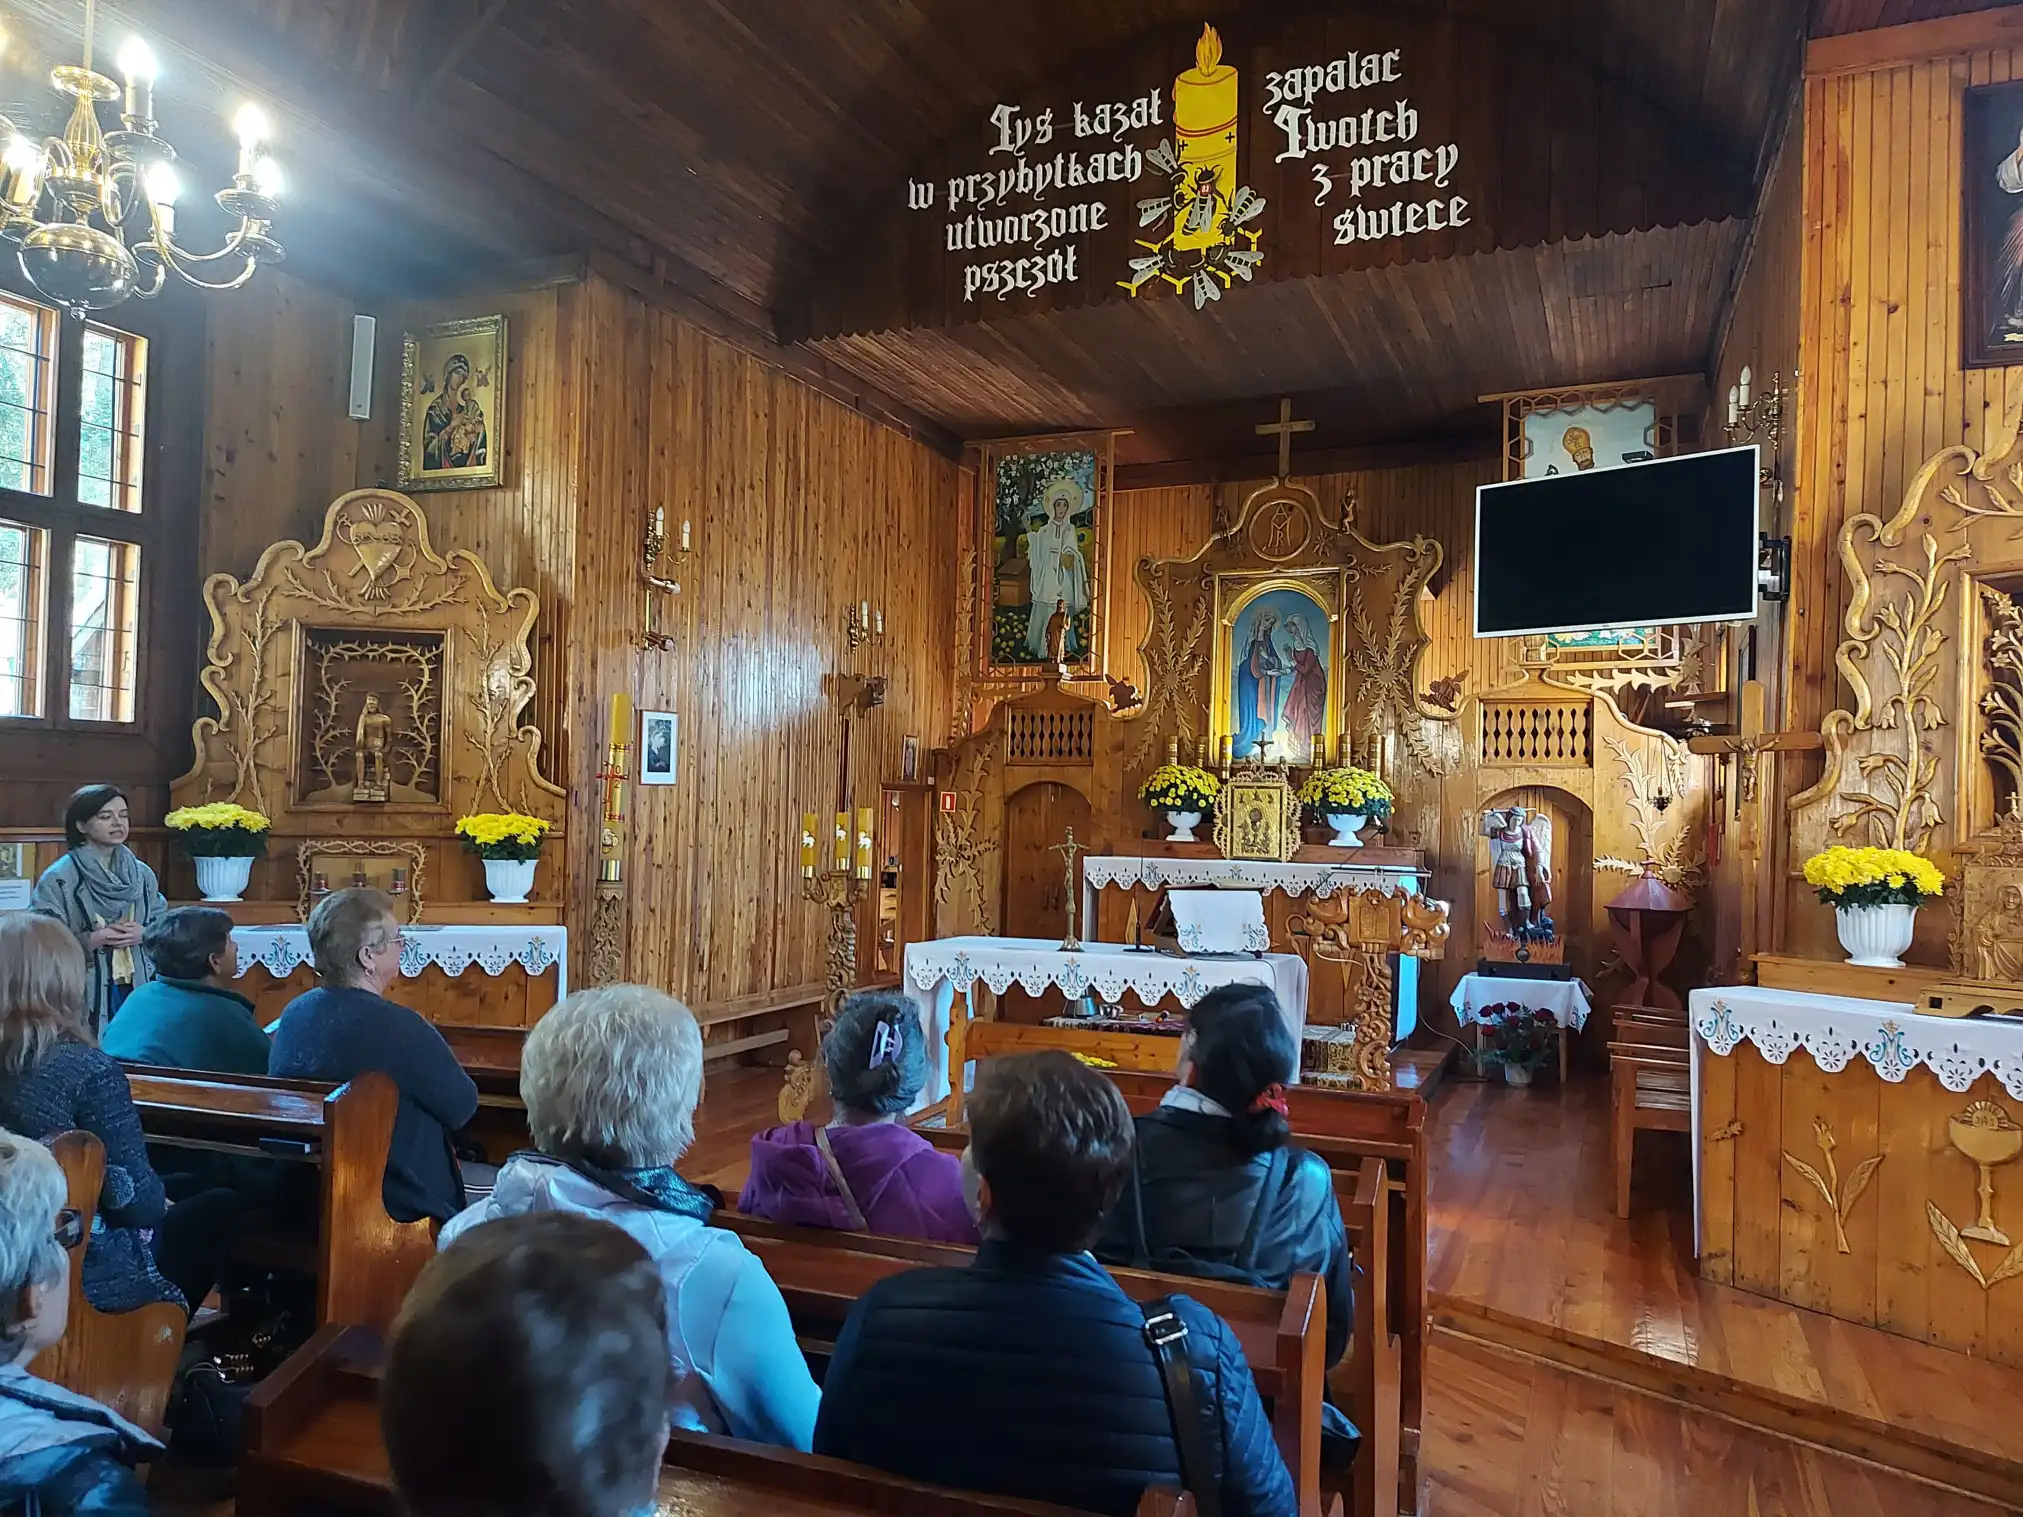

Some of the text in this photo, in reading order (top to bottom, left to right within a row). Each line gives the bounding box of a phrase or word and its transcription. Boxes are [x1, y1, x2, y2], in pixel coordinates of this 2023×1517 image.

[989, 87, 1164, 156] Tyś kazał
[1274, 98, 1418, 163] Twoich
[908, 143, 1142, 213] w przybytkach
[1311, 143, 1459, 207] z pracy
[946, 201, 1109, 251] utworzone
[964, 244, 1079, 302] pszczół
